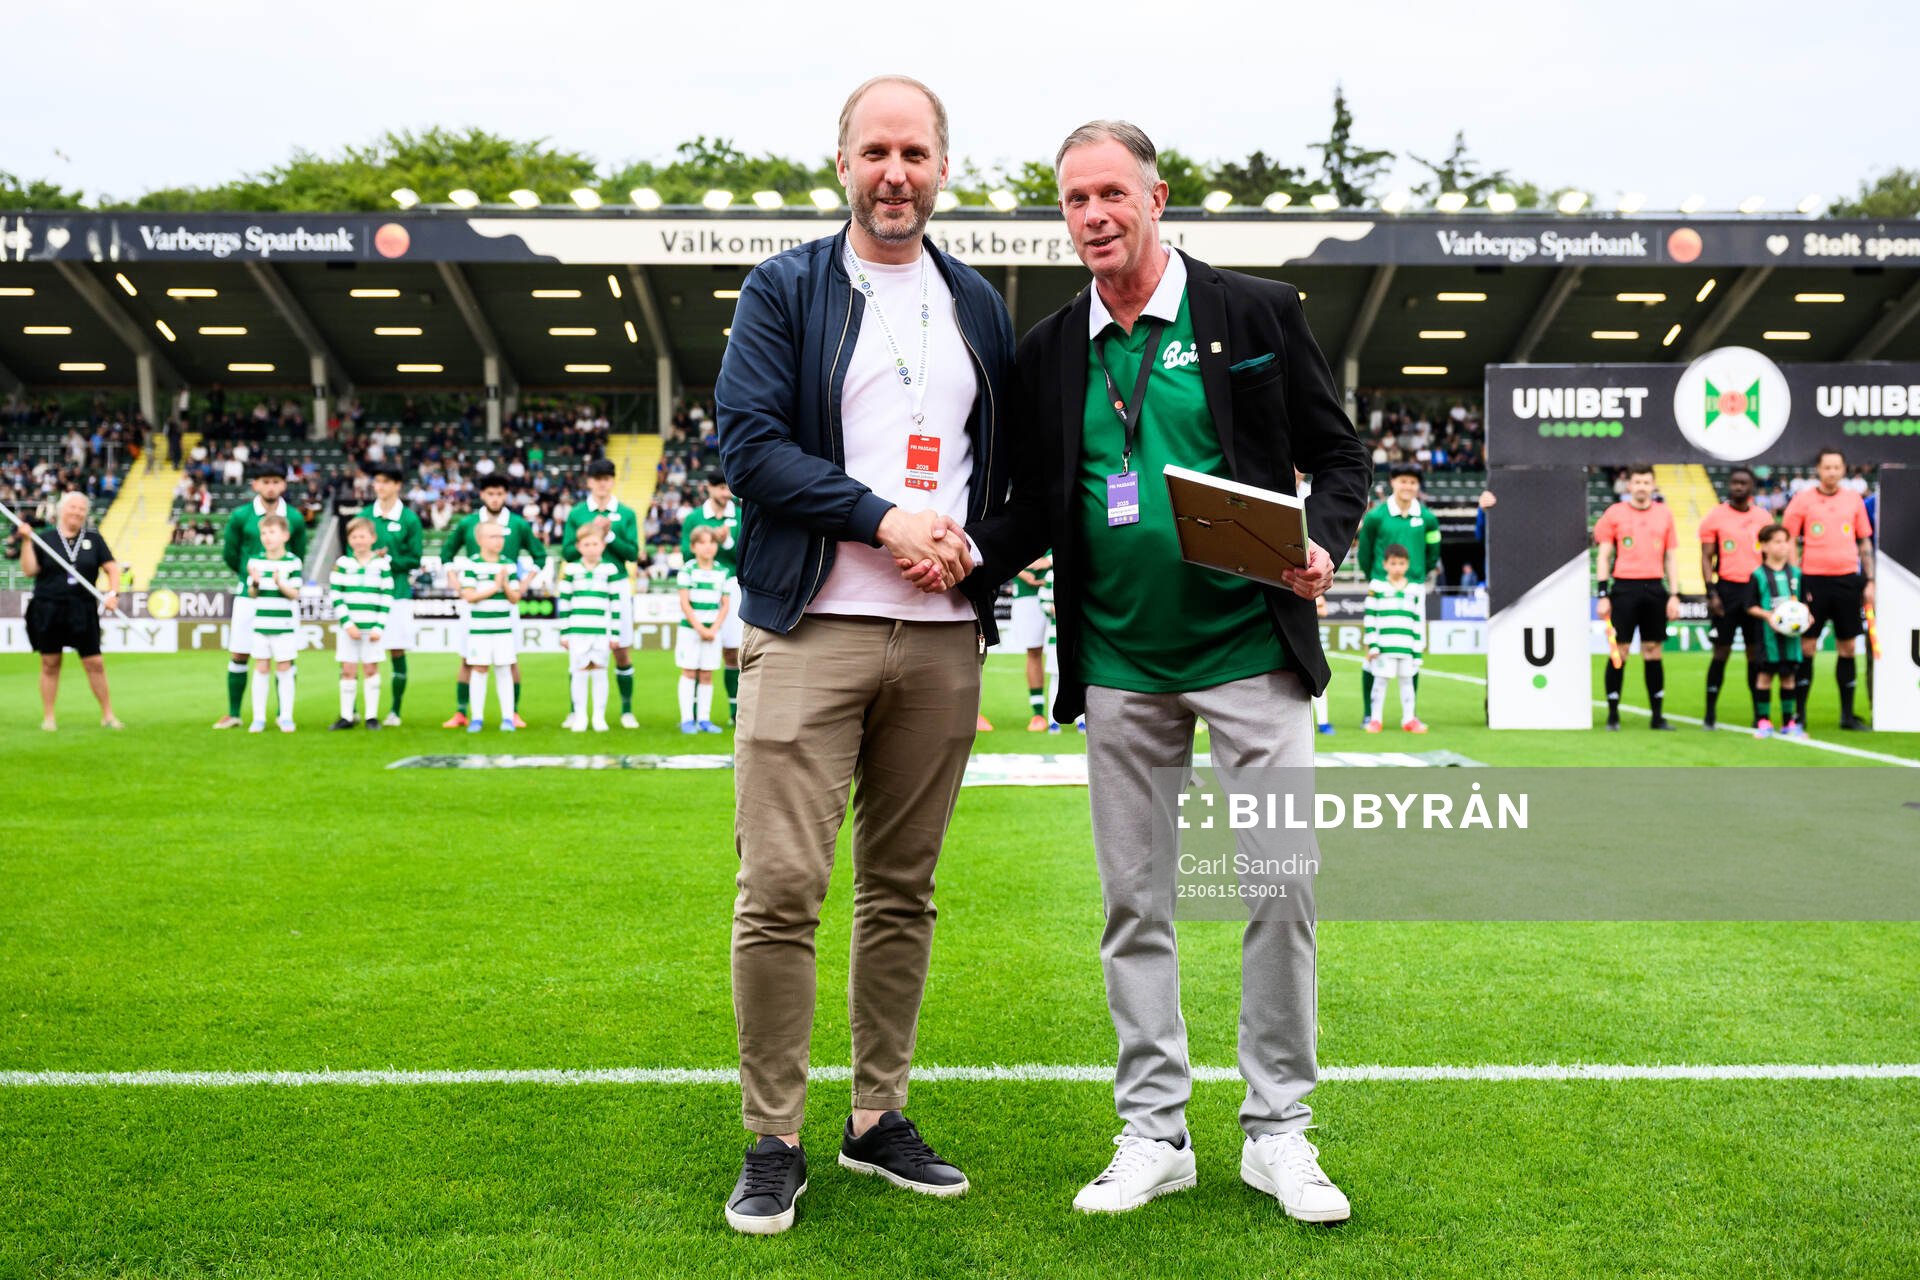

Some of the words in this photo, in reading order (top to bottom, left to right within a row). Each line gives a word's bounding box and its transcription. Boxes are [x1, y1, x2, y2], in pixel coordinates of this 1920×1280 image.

[140, 225, 242, 258] Varbergs
[244, 225, 354, 258] Sparbank
[661, 231, 802, 253] Välkomm
[1437, 230, 1537, 263] Varbergs
[1540, 230, 1647, 262] Sparbank
[1803, 232, 1862, 256] Stolt
[1162, 340, 1200, 370] Boi
[1512, 387, 1649, 419] UNIBET
[1523, 627, 1555, 668] U
